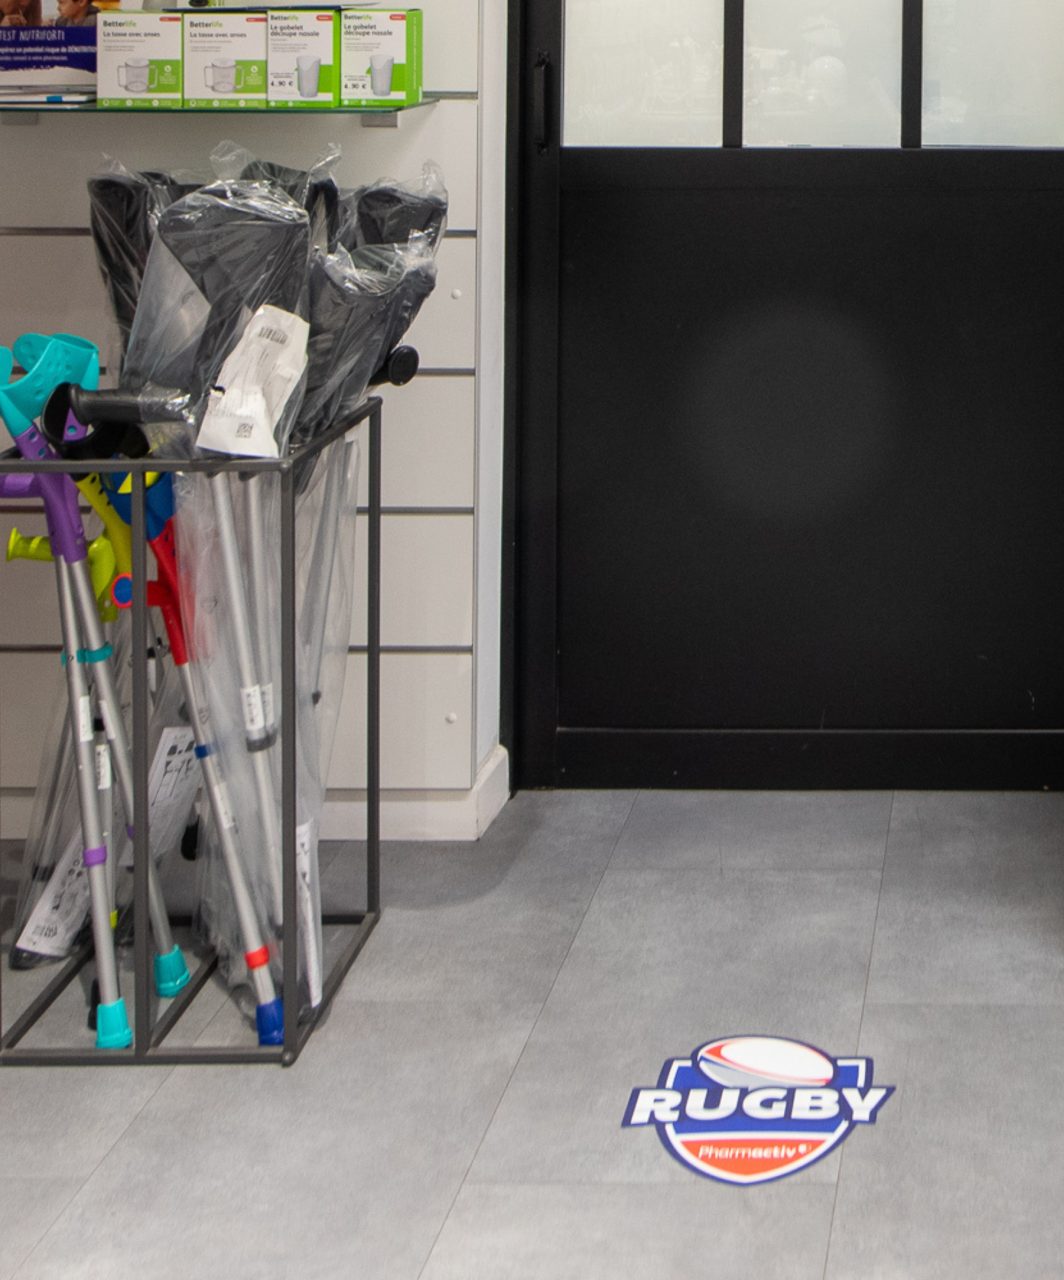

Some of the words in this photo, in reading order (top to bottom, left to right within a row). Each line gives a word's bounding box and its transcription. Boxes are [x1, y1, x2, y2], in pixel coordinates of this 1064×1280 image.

[19, 30, 65, 41] NUTRIFORTI
[630, 1088, 886, 1124] RUGBY
[698, 1144, 796, 1160] Pharmactiv
